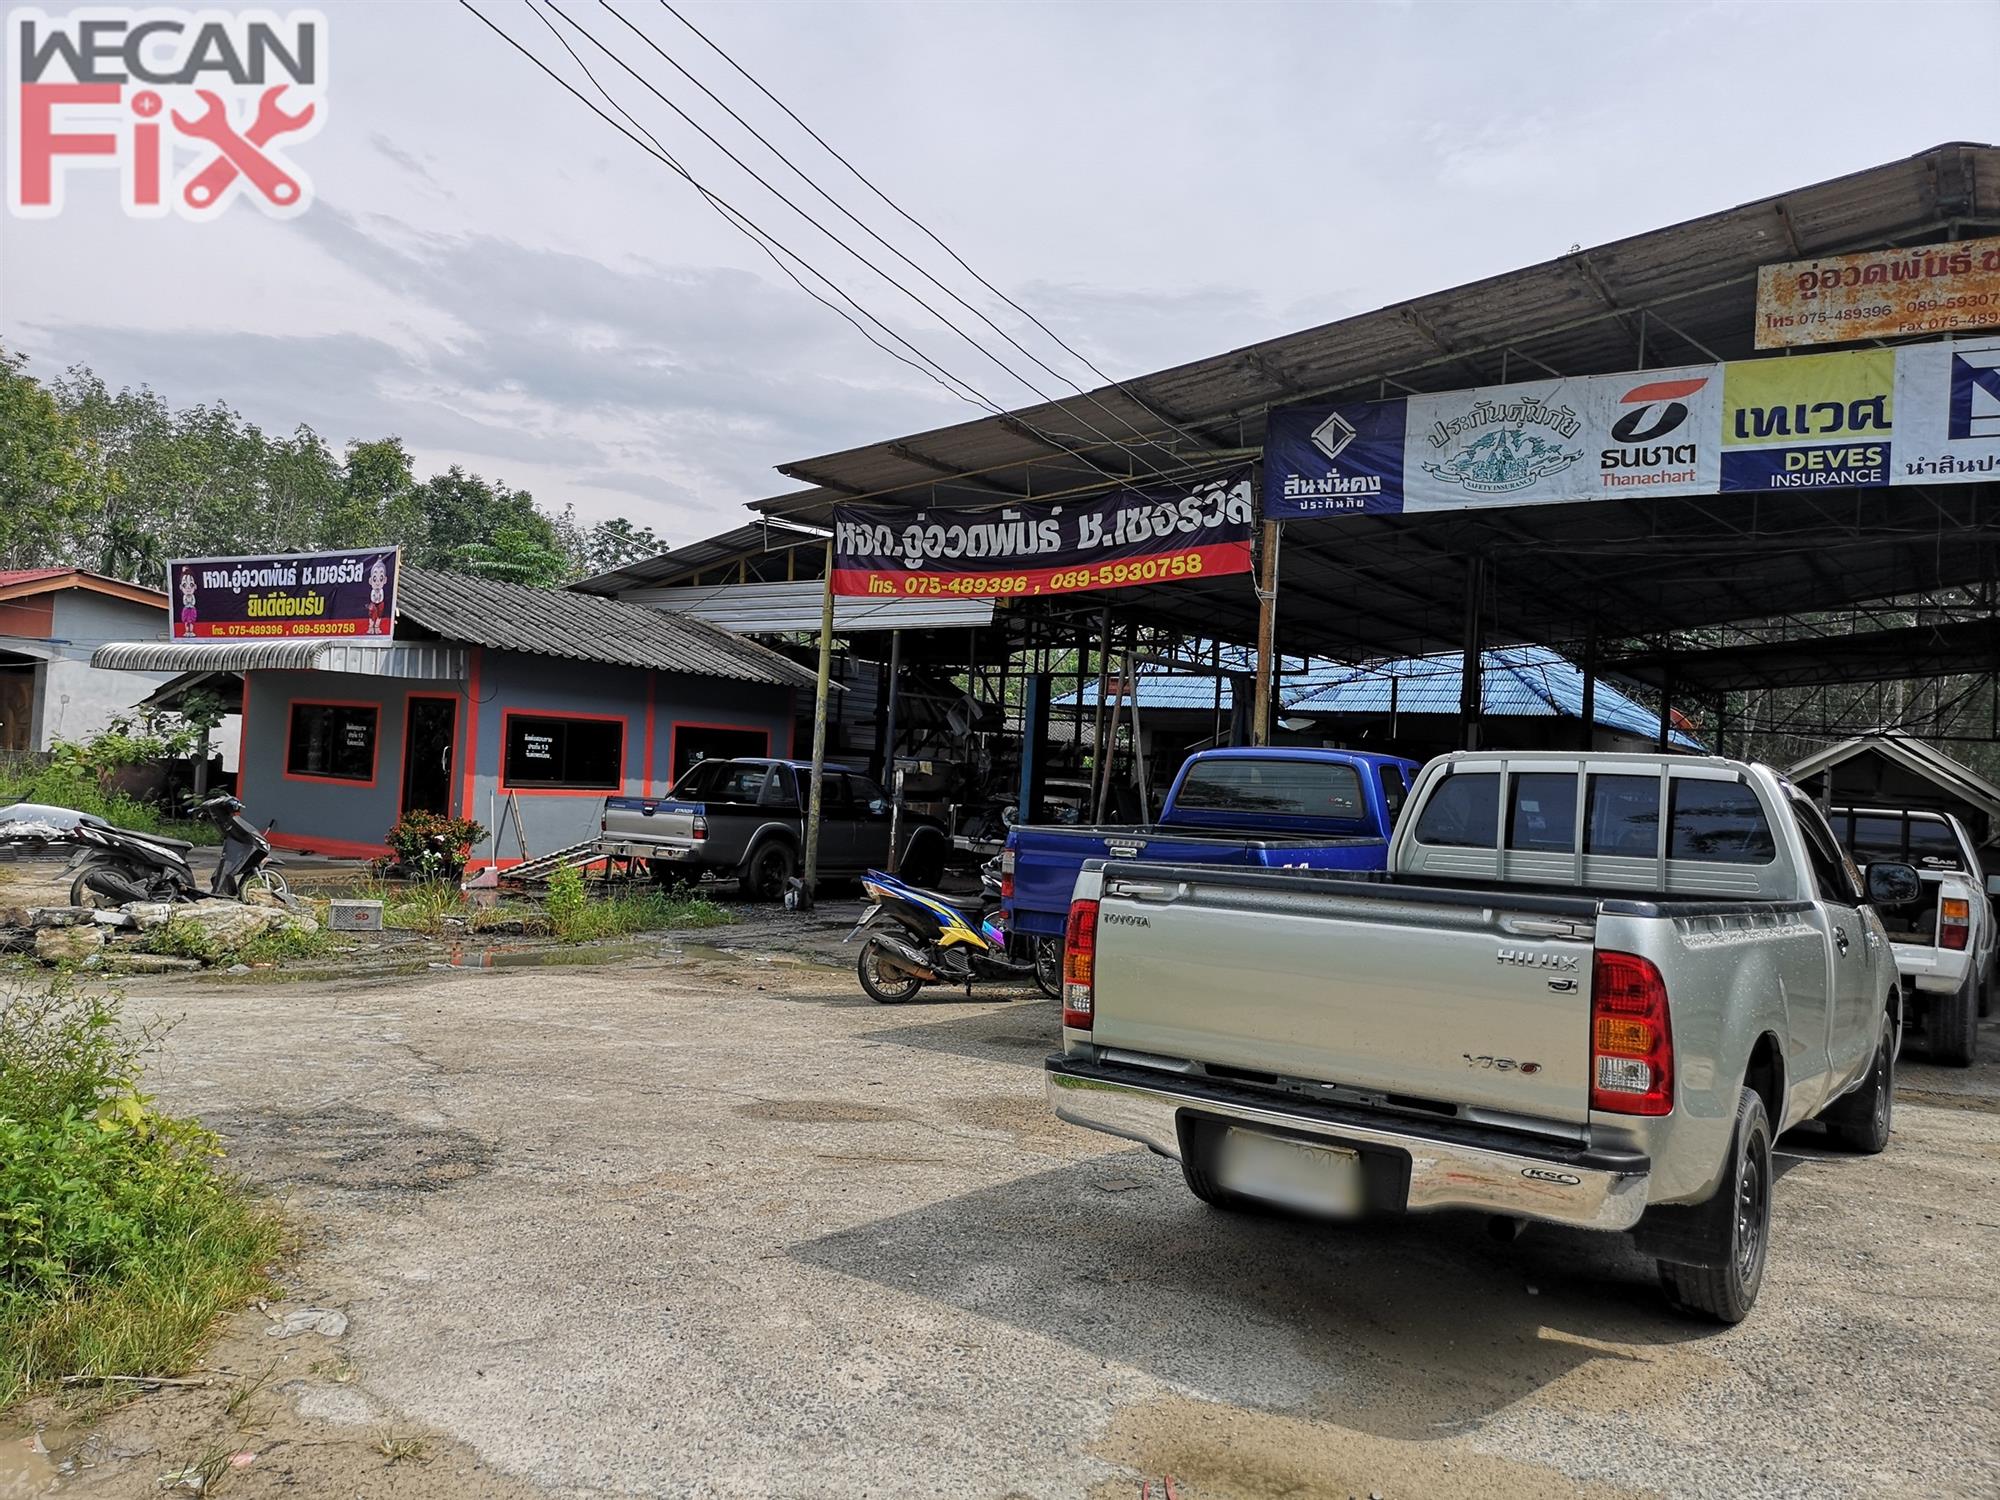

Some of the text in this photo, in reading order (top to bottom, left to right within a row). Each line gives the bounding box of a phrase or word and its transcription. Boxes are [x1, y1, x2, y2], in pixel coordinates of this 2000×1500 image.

[1765, 313, 1794, 328] โทร
[1800, 305, 1892, 325] 075-489396
[1899, 311, 2000, 332] Fax 075-489
[1428, 396, 1581, 448] ประกันคุ้มภัย
[1734, 394, 1893, 439] เทเวศ
[1601, 444, 1696, 469] ธนชาต
[1785, 446, 1883, 471] DEVES
[1284, 468, 1381, 494] สินมั่นคง
[1465, 480, 1492, 491] SAFETY
[1600, 468, 1696, 487] Thanachart
[1770, 468, 1882, 487] INSURANCE
[868, 574, 897, 593] โทร.
[904, 576, 1028, 594] 075-489396
[1050, 553, 1203, 590] 089-5930758
[247, 591, 325, 616] ยินดีต้อนรับ
[228, 625, 283, 635] 075-489396
[292, 623, 355, 634] 089-5930758
[1103, 913, 1151, 928] TOYOTA
[1497, 949, 1579, 973] HILUX
